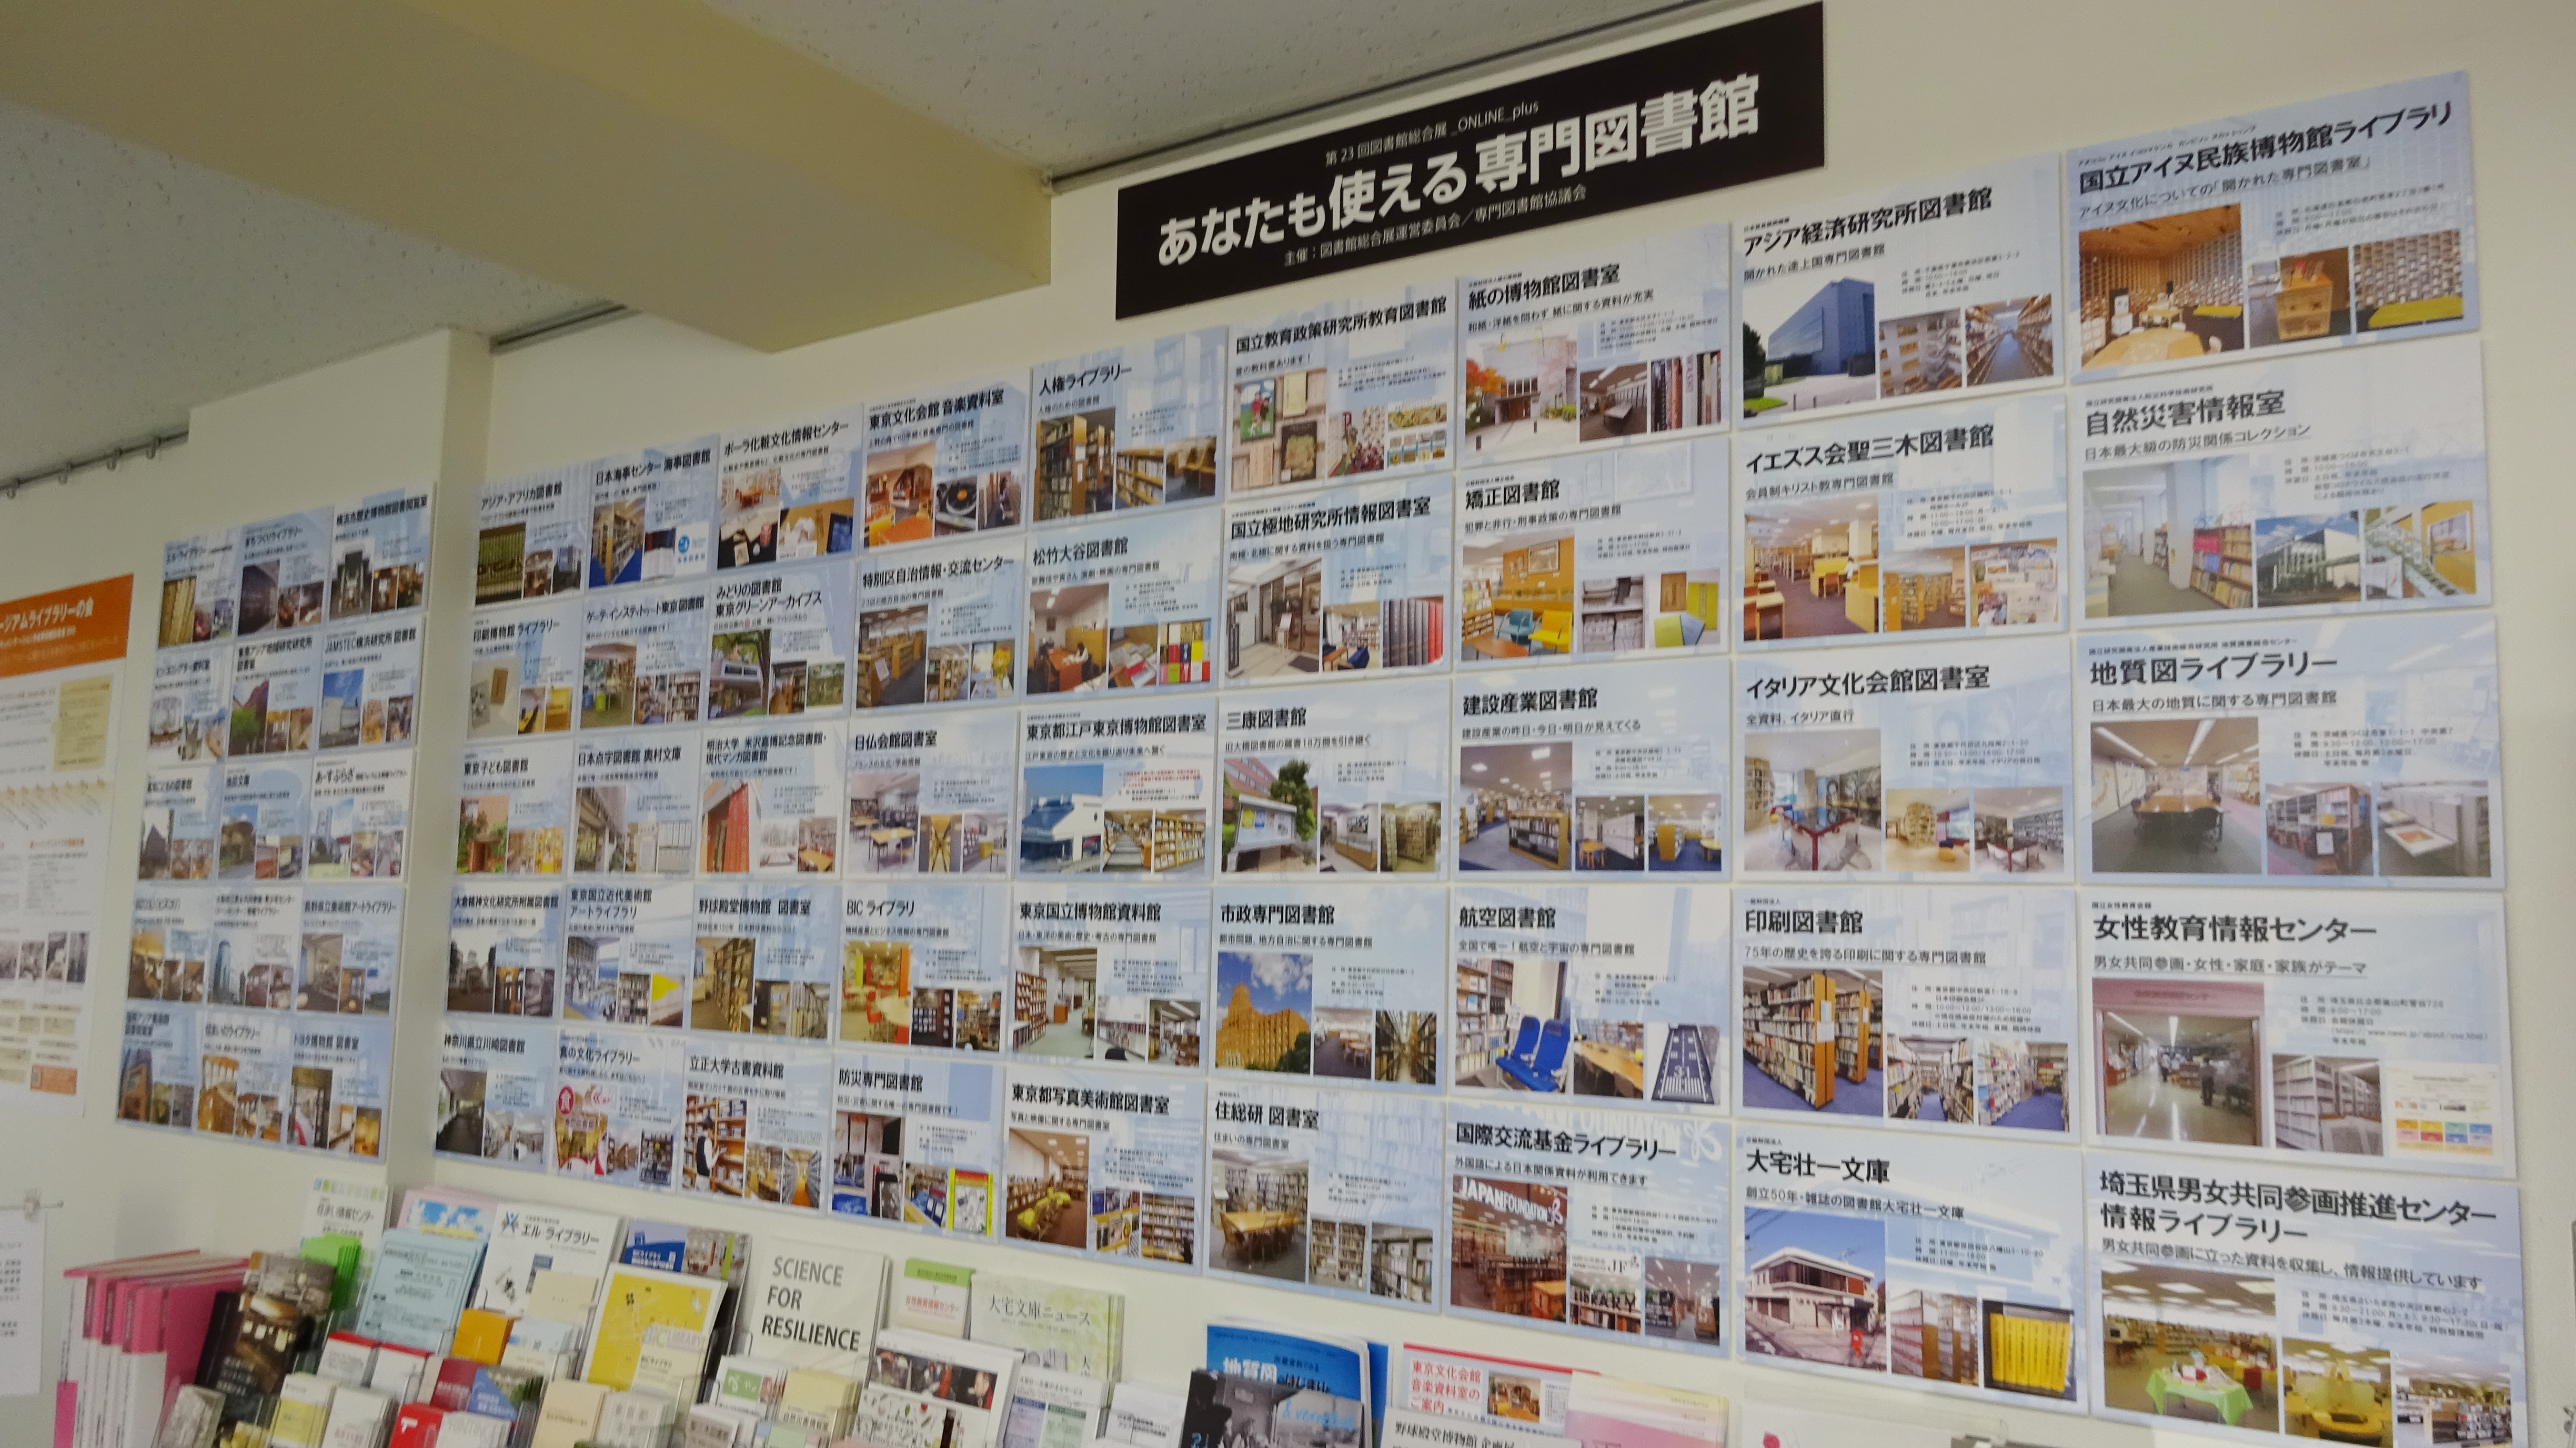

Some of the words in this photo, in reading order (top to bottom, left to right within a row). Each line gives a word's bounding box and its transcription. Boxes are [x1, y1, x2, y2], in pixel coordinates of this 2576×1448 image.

[2080, 100, 2451, 195] 国立アイヌ民族博物館ライブラリ
[1156, 72, 1761, 268] あなたも使える専門図書館
[1744, 186, 1993, 257] アジア経済研究所図書館
[1744, 244, 1885, 283] 開かれた途上国専門図書館
[1468, 263, 1620, 313] 紙の博物館図書室
[1236, 296, 1446, 355] 国立教育政策研究所教育図書館
[1039, 363, 1132, 397] 人権ライブラリー
[870, 400, 940, 430] 東京文化会館
[943, 388, 1004, 415] 音楽資料室
[2086, 390, 2286, 437] 自然災害情報室
[724, 421, 849, 456] ポーラ化粧文化情報センター
[1746, 424, 1994, 474] イエズス会聖三木図書館
[2085, 424, 2311, 461] 日本最大級の防災関係コレクション
[596, 463, 661, 486] 日本海事センター
[664, 448, 711, 472] 海事図書館
[1465, 479, 1560, 511] 矯正図書館
[1746, 472, 1894, 501] 会員制キリスト教専門図書館
[1231, 496, 1431, 540] 国立極地研究所情報図書室
[1465, 504, 1622, 534] 犯罪と非行・刑事政策の専門図書館
[1033, 536, 1128, 567] 松竹大谷図書館
[863, 554, 1014, 589] 特別区自治情報・交流センター
[717, 577, 782, 600] みどりの図書館
[716, 590, 822, 619] 東京グリーンアーカイブス
[1747, 665, 1990, 699] イタリア文化会館図書室
[2090, 651, 2338, 686] 地質図ライブラリー
[1463, 687, 1598, 716] 建設産業図書館
[2092, 690, 2337, 713] 日本最大の地質に関する専門図書館
[1027, 712, 1206, 741] 東京都江戸東京博物館図書室
[1226, 707, 1306, 731] 三康図書館
[856, 729, 937, 751] 日仏会館図書室
[571, 888, 652, 904] 東京国立近代美術館
[699, 898, 771, 915] 野球殿堂博物館
[778, 899, 811, 916] 図書室
[847, 899, 863, 916] BIC
[867, 899, 914, 917] ライブラリ
[1020, 901, 1161, 922] 東京国立博物館資料館
[570, 905, 637, 920] アートライブラリ
[1220, 903, 1335, 925] 市政専門図書館
[1459, 907, 1556, 929] 航空図書館
[1745, 910, 1863, 934] 印刷図書館
[2094, 914, 2377, 942] 女性教育情報センター
[1745, 947, 1987, 966] 75年の歴史を誇る印刷に関する専門図書館
[2094, 955, 2367, 975] 男女共同参画・女性・家庭・家族がテーマ
[689, 1054, 784, 1080] 立正大学古書資料館
[839, 1068, 923, 1092] 防災専門図書館
[1012, 1082, 1170, 1115] 東京都写真美術館図書室
[1215, 1100, 1263, 1125] 住総研
[1269, 1105, 1319, 1131] 図書室
[1456, 1121, 1677, 1161] 国際交流基金ライブラリー
[1455, 1155, 1648, 1186] 外国語による日本関係資料が利用できます
[1746, 1149, 1890, 1183] 大宅壮一文庫
[1745, 1185, 1965, 1220] 創立50年・雑誌の図書館大宅壮一文庫
[2100, 1171, 2497, 1225] 埼玉県男女共同参画推進センター
[2100, 1203, 2308, 1242] 情報ライブラリー
[772, 1255, 843, 1286] SCIENCE
[767, 1285, 802, 1310] FOR
[990, 1295, 1090, 1326] 大宅文庫ニュース
[761, 1314, 860, 1352] RESILIENCE
[1412, 1359, 1481, 1384] 東京文化会館
[1411, 1379, 1480, 1401] 音楽資料室の
[1411, 1394, 1445, 1414] ご案内
[1395, 1420, 1477, 1447] 野球殿堂博物館
